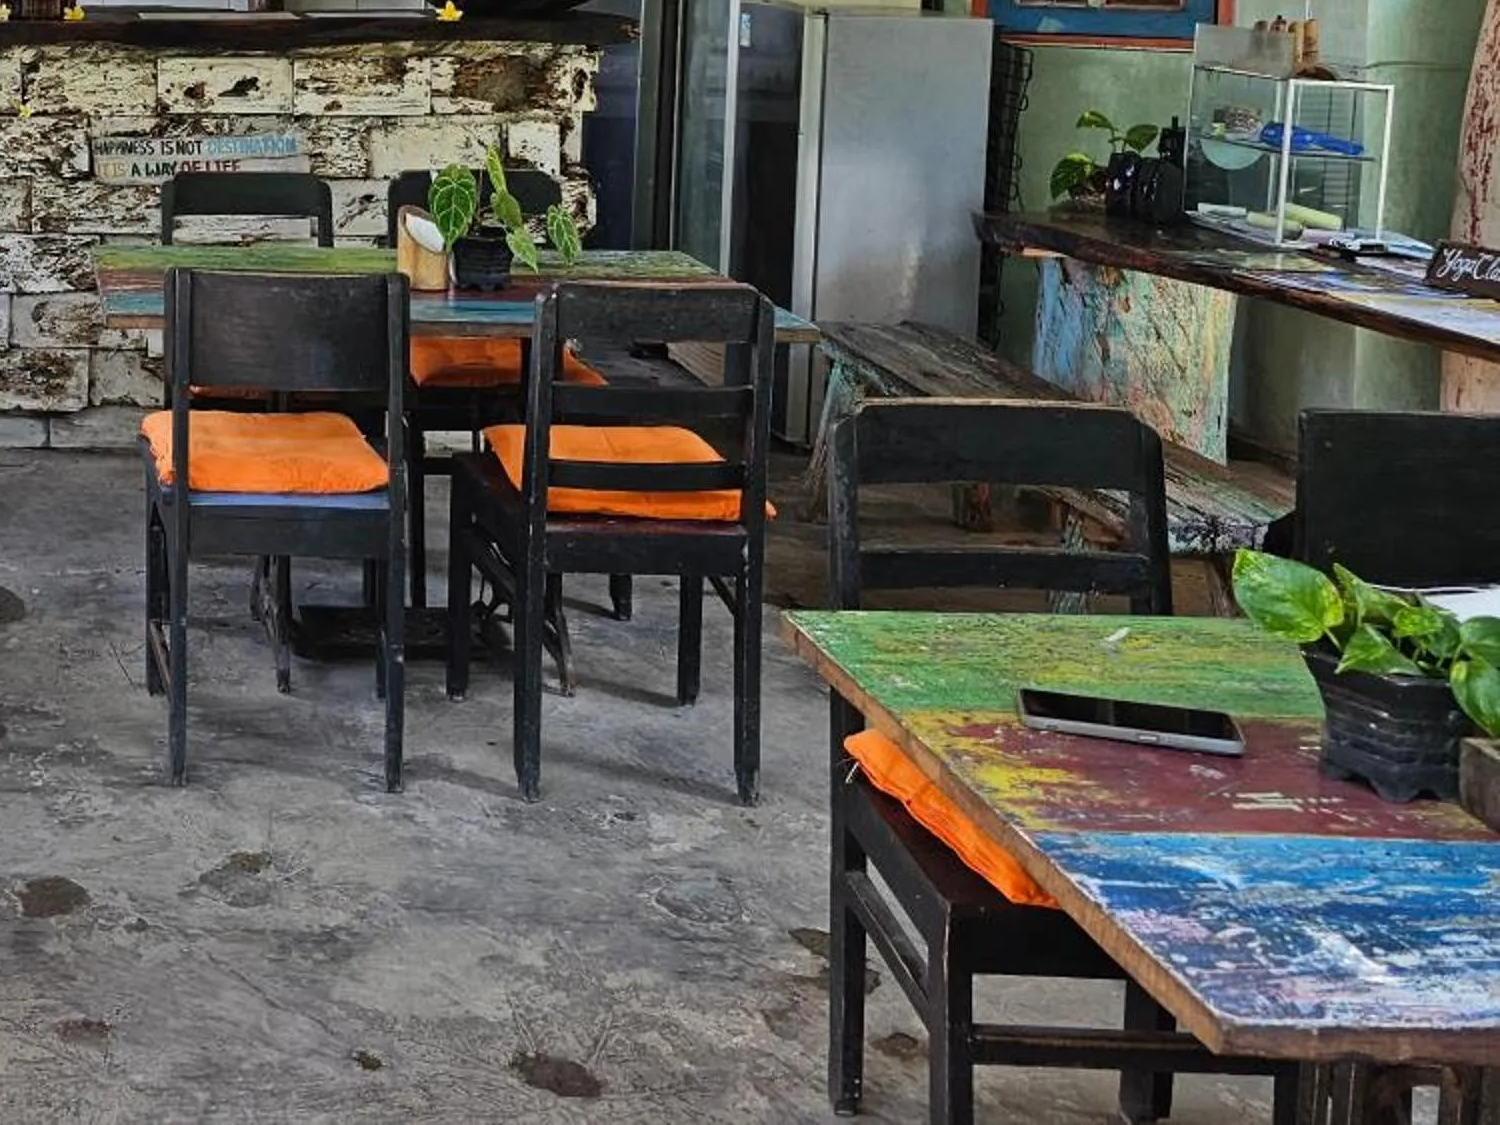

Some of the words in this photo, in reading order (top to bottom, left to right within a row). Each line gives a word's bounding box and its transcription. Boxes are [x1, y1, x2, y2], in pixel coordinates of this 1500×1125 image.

[161, 140, 175, 155] IS
[176, 139, 202, 155] NOT
[132, 162, 142, 177] A
[145, 160, 177, 177] WAY
[1436, 248, 1476, 282] Yoga
